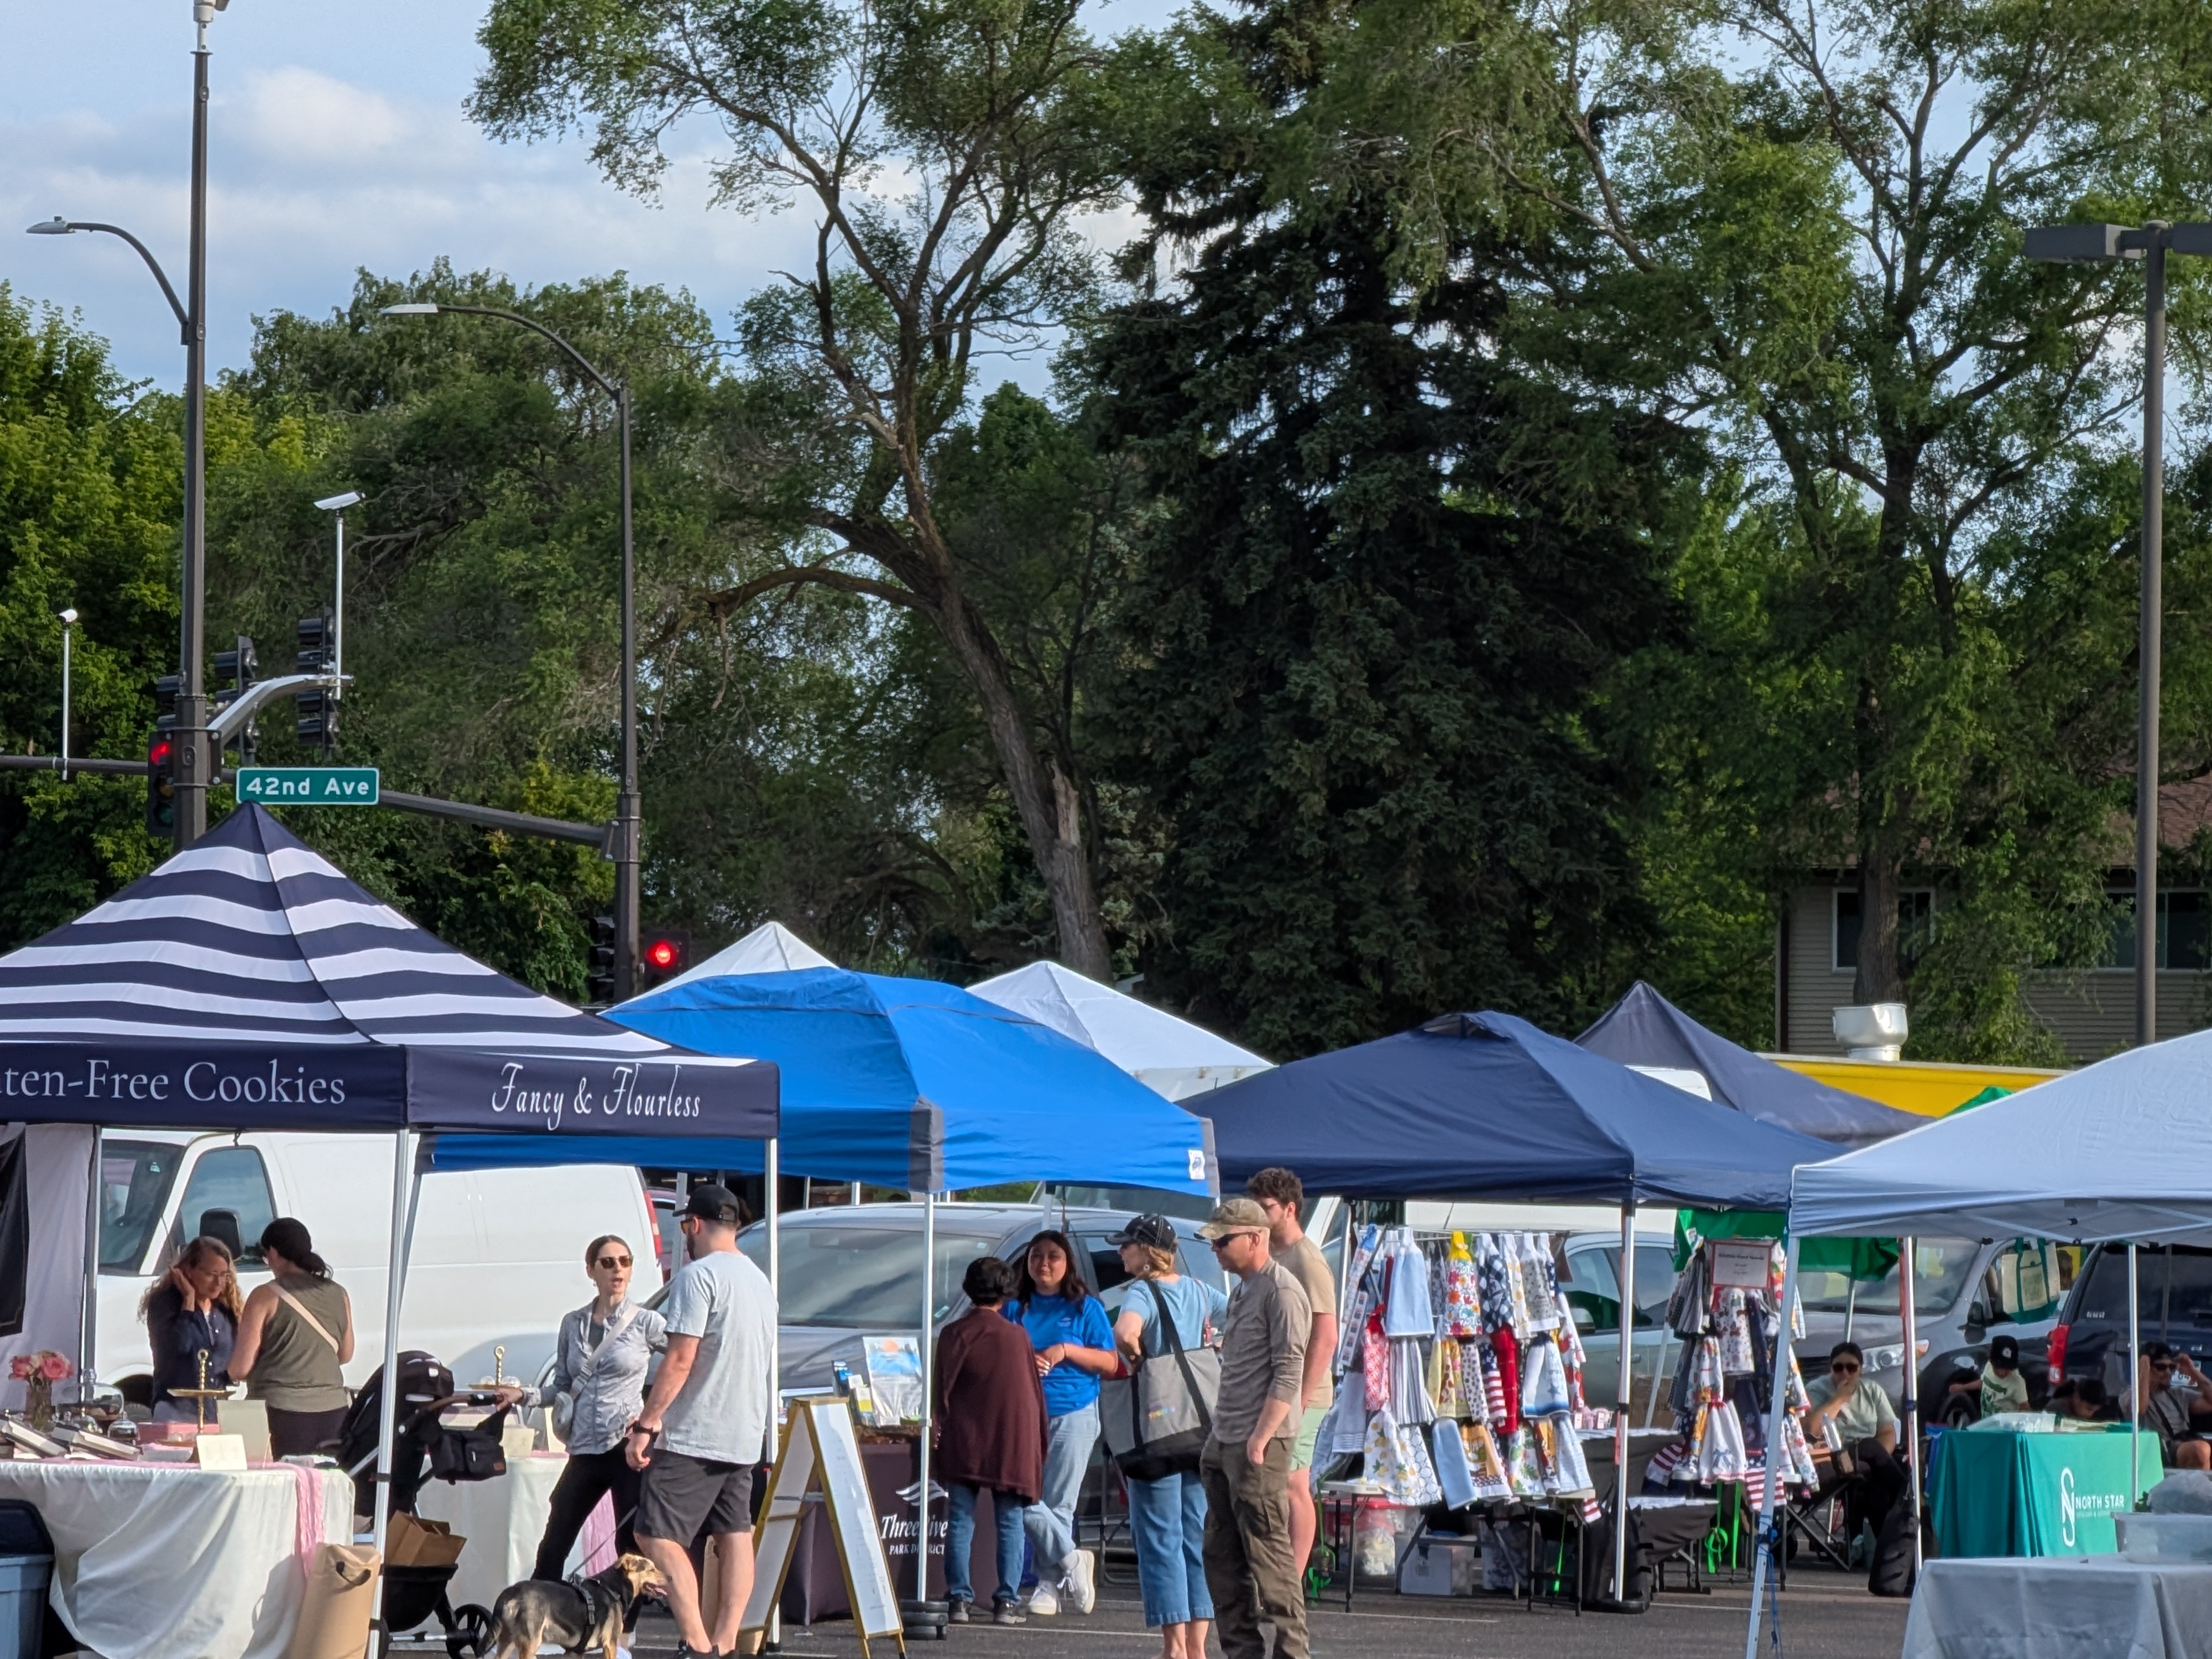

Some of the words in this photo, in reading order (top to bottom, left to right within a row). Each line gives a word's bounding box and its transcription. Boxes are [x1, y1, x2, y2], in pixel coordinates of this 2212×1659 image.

[246, 777, 310, 795] 42nd
[324, 777, 369, 795] Ave
[0, 1059, 169, 1100] ten-Free
[184, 1058, 346, 1104] Cookies
[492, 1062, 564, 1131] Fancy
[574, 1077, 593, 1114] &
[603, 1063, 701, 1118] Flourless
[2075, 1496, 2103, 1510] NORTH
[2105, 1494, 2125, 1509] STAR
[889, 1543, 910, 1555] PARK
